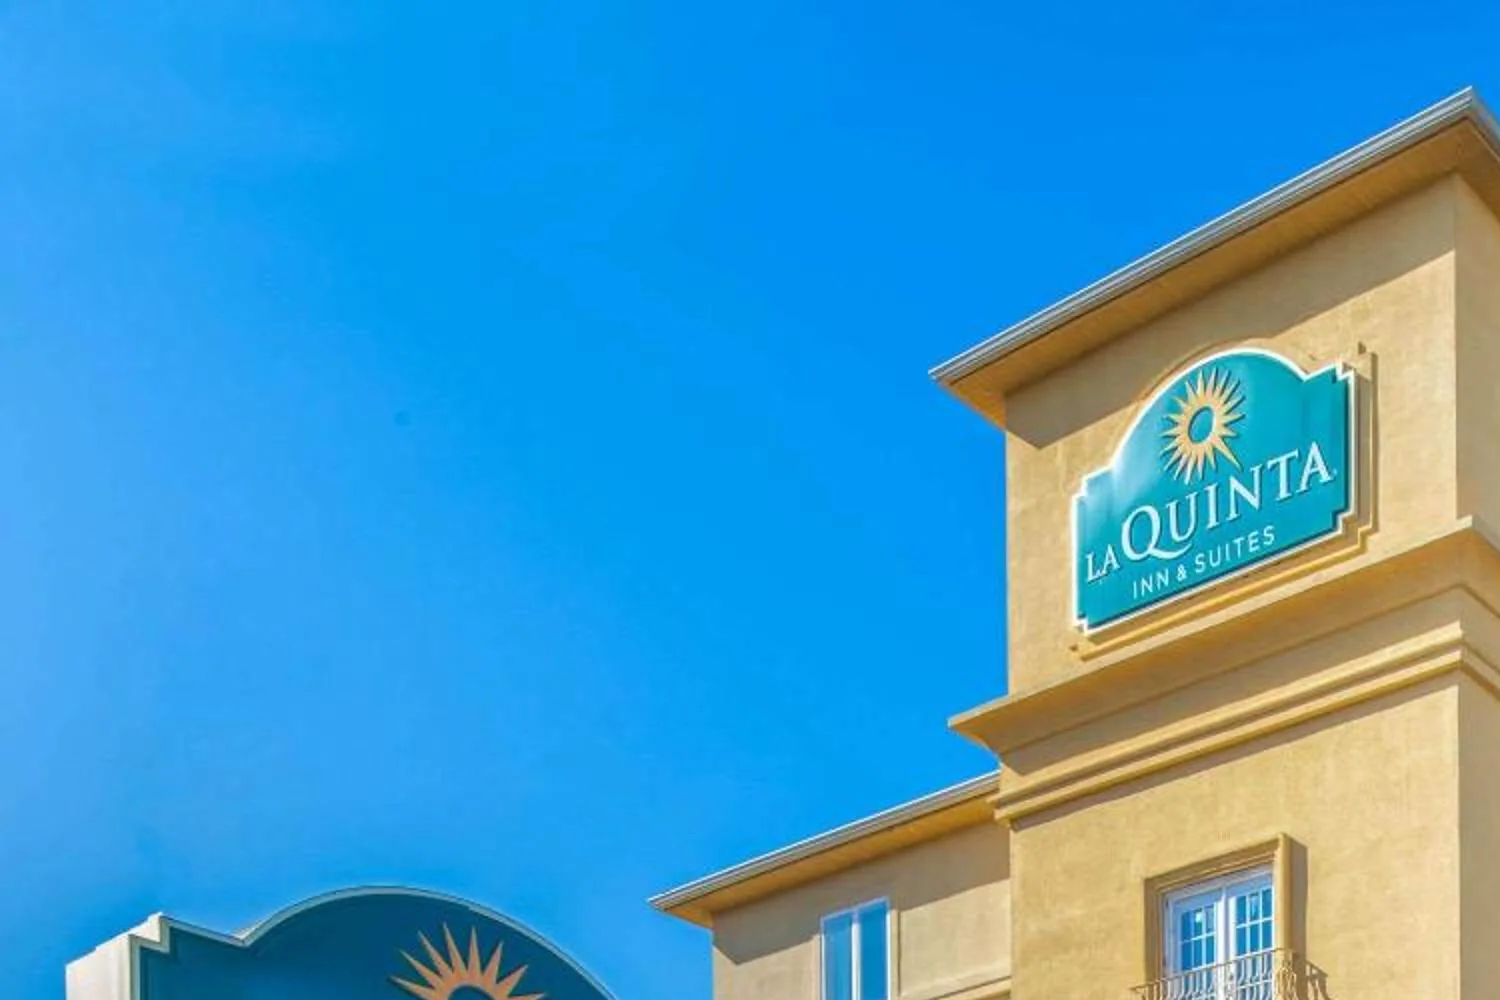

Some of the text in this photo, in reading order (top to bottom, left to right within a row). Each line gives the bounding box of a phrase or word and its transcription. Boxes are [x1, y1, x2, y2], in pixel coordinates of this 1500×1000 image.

[1086, 441, 1333, 582] LA QUINTA
[1133, 525, 1275, 599] INN & SUITES
